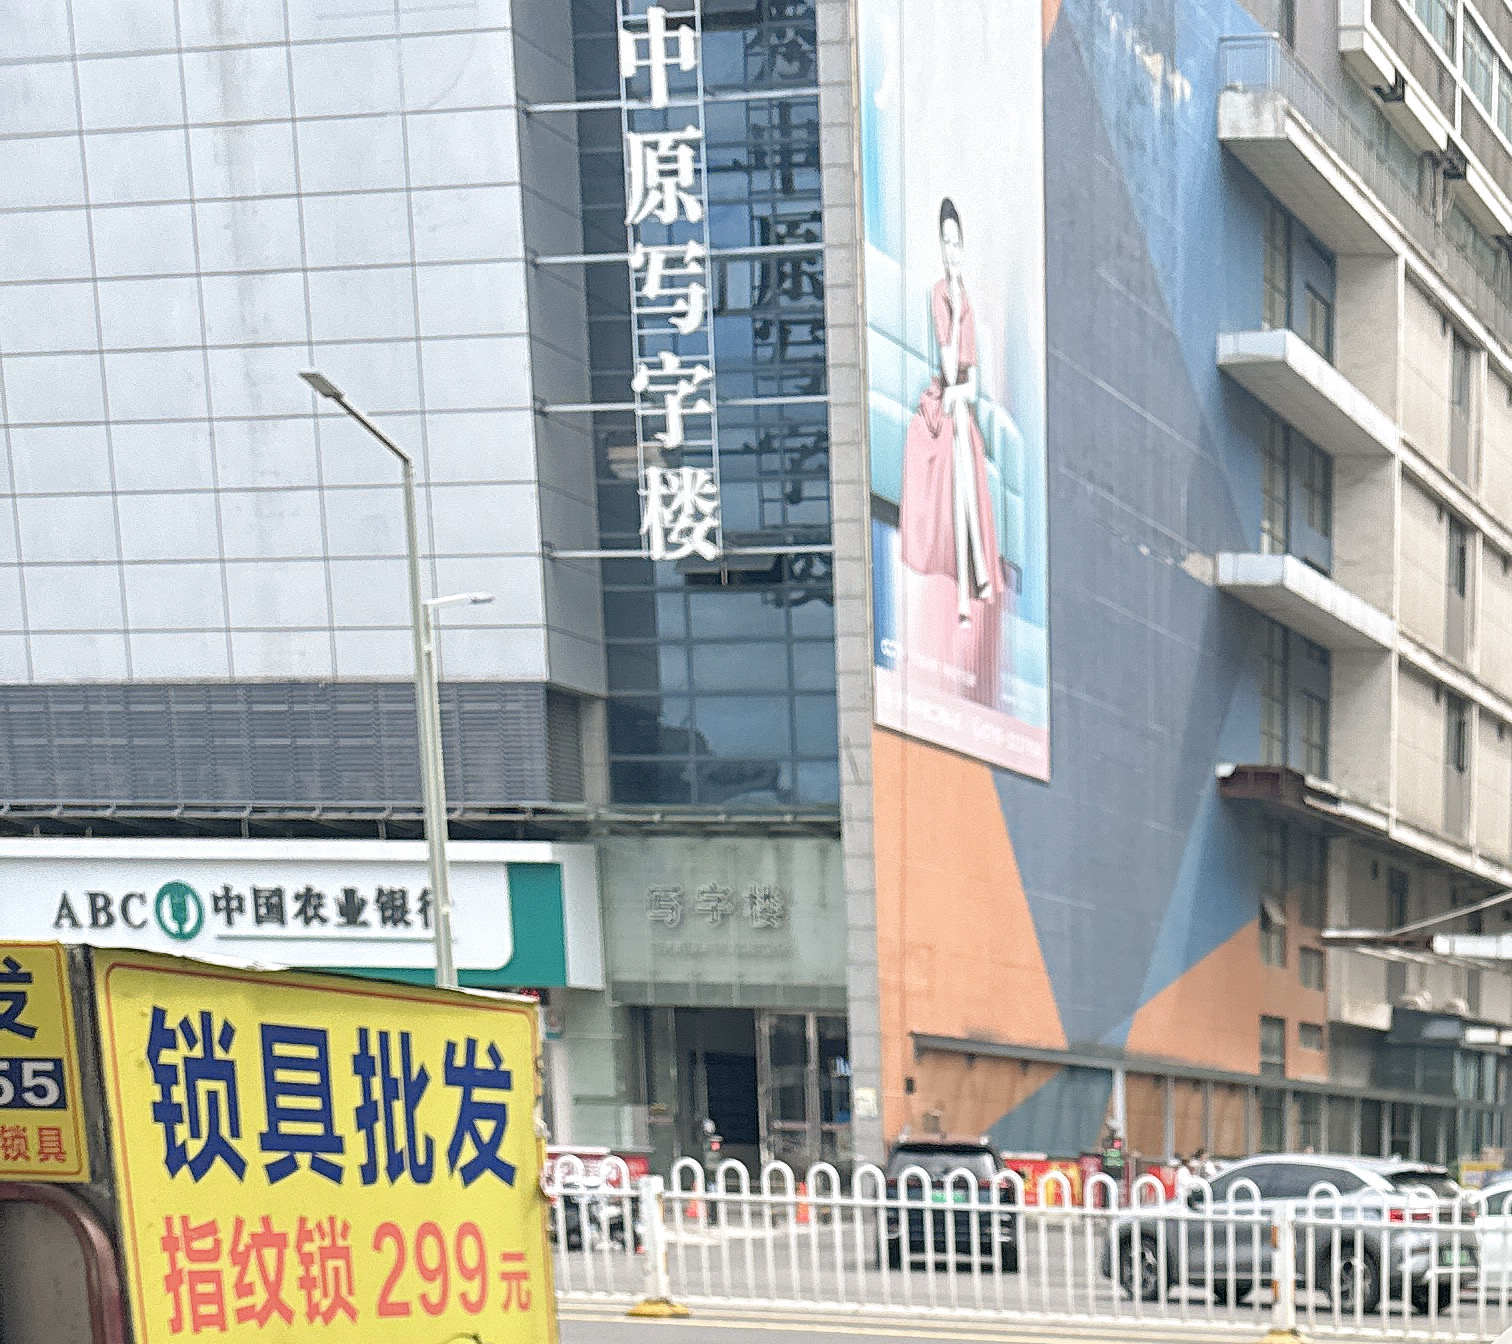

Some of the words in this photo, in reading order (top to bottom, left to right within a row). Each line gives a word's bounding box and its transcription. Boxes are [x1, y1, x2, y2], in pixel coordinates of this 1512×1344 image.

[618, 5, 724, 562] 中原写字楼
[53, 890, 148, 929] ABC
[647, 882, 787, 929] 写字楼
[147, 1006, 516, 1188] 锁具批发
[161, 1214, 360, 1335] 指纹锁
[372, 1220, 532, 1318] 299元
